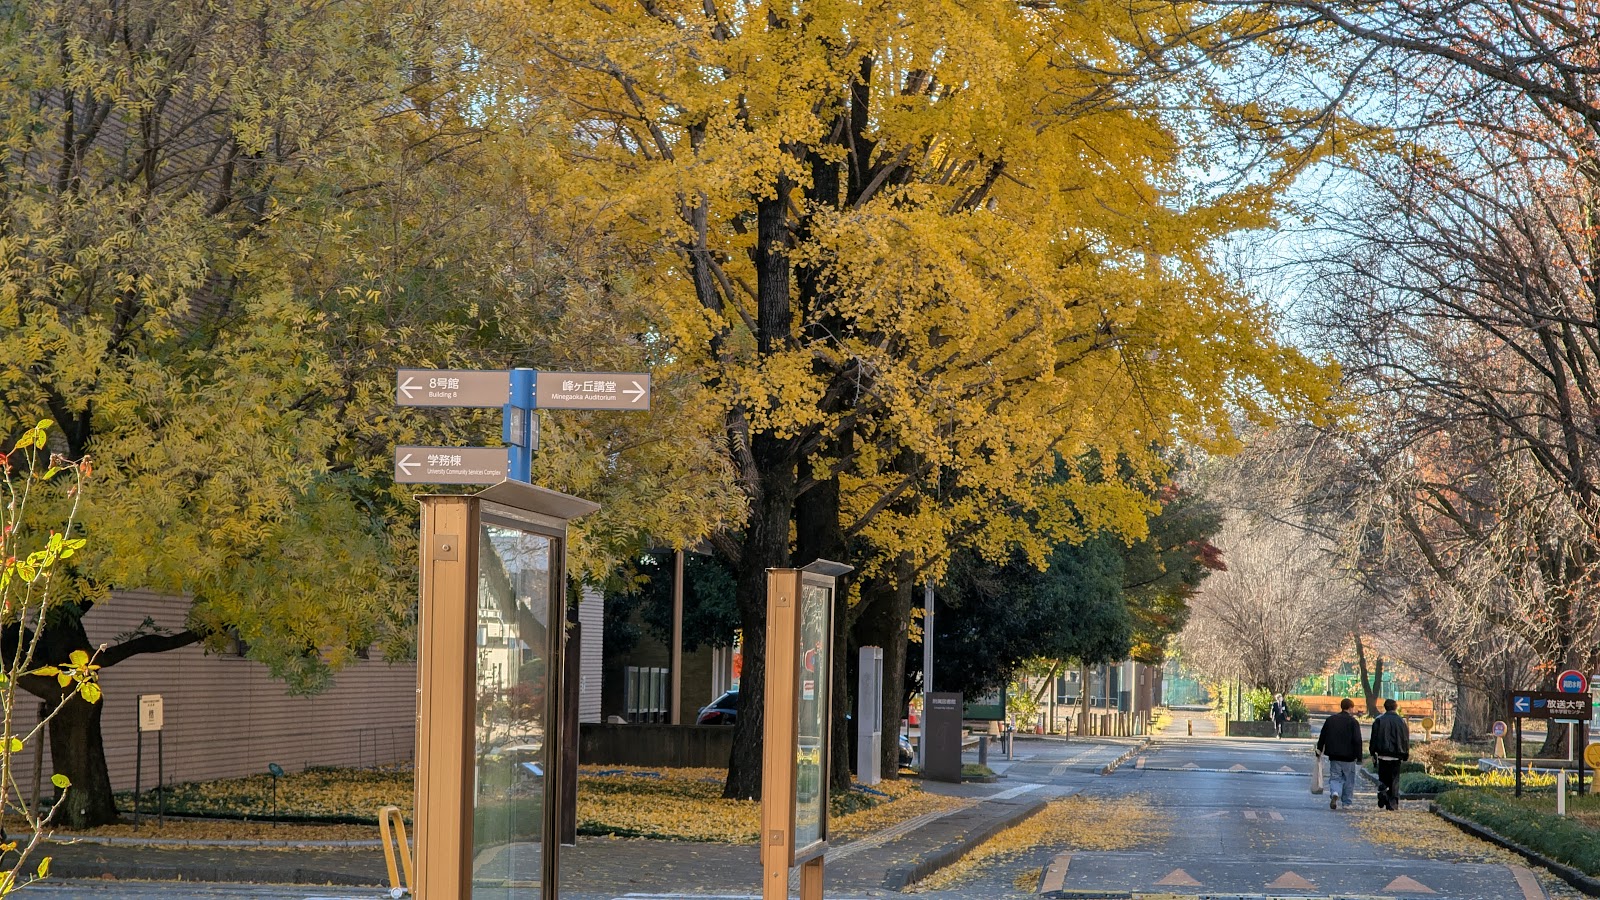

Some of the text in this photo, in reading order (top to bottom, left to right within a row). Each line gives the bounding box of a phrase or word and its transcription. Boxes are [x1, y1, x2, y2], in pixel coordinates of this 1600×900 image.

[429, 378, 460, 390] 8号館
[429, 391, 452, 399] Building
[551, 393, 584, 401] Minegaoka
[427, 454, 462, 467] 学務棟
[427, 468, 446, 476] University
[446, 468, 468, 476] Community
[484, 469, 501, 477] Complex
[1547, 699, 1585, 709] 放送大学
